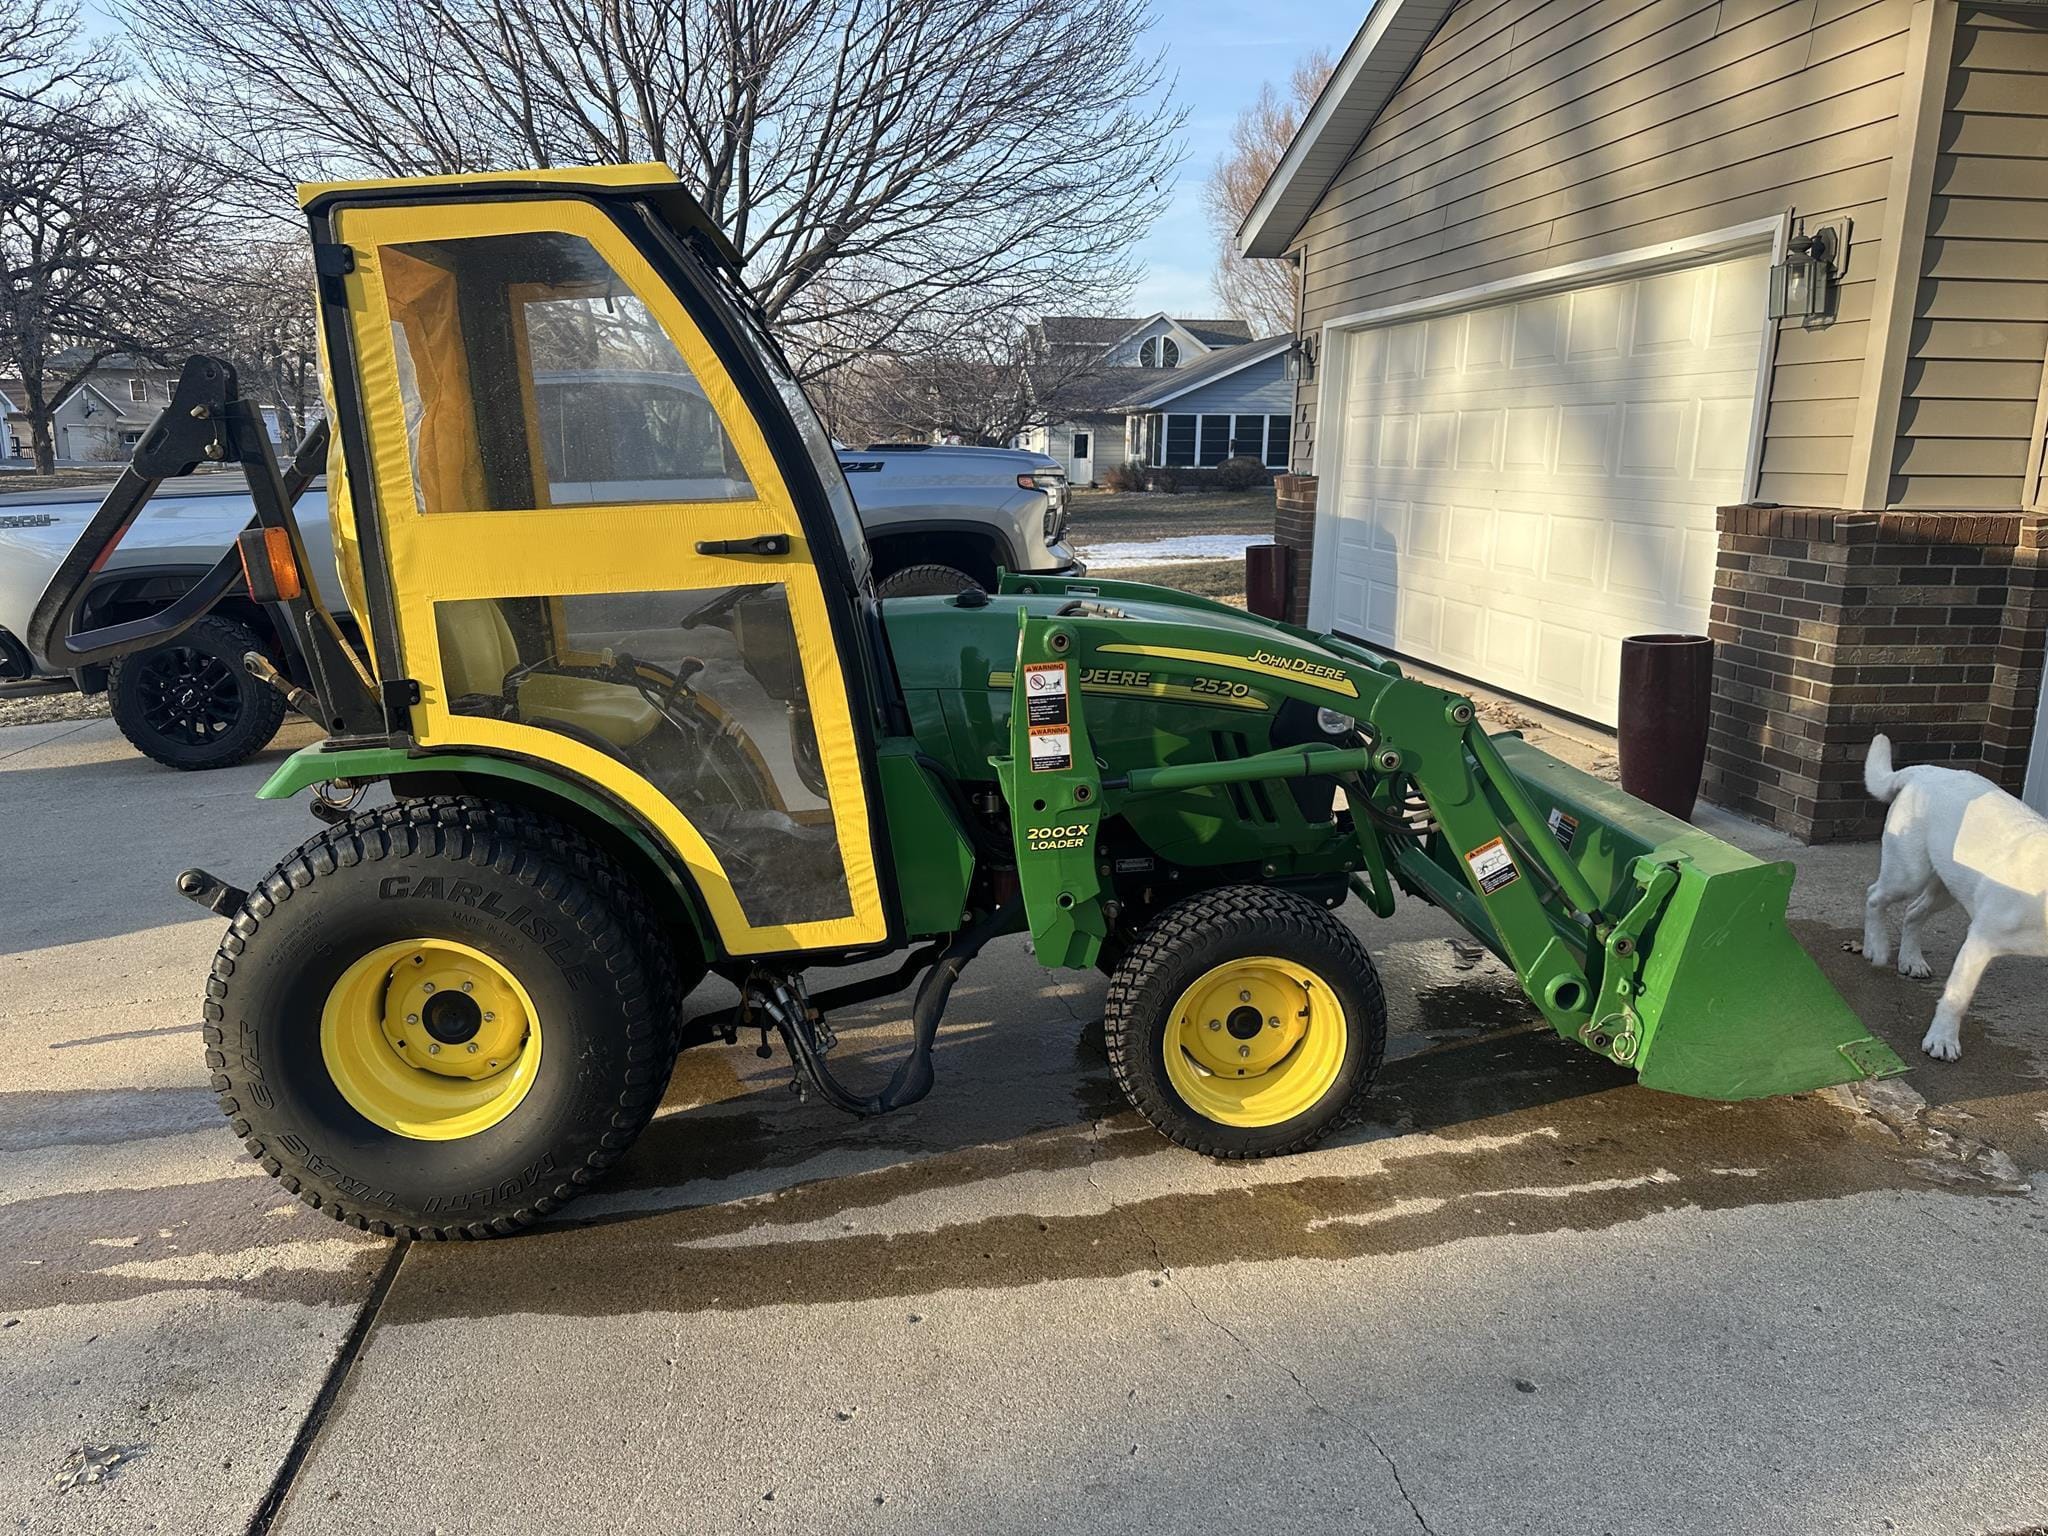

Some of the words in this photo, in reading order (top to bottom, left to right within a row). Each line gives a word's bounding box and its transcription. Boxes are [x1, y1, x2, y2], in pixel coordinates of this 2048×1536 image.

[1031, 663, 1064, 671] WARNING
[1247, 649, 1292, 669] JOHN
[1292, 658, 1346, 680] DEERE
[1193, 677, 1249, 698] 2520
[1035, 726, 1068, 735] WARNING
[1027, 824, 1090, 839] 200CX
[1031, 838, 1084, 850] LOADER
[378, 876, 592, 991] CARLISLE
[277, 1134, 399, 1208] TRAC
[423, 1152, 557, 1212] MULTI
